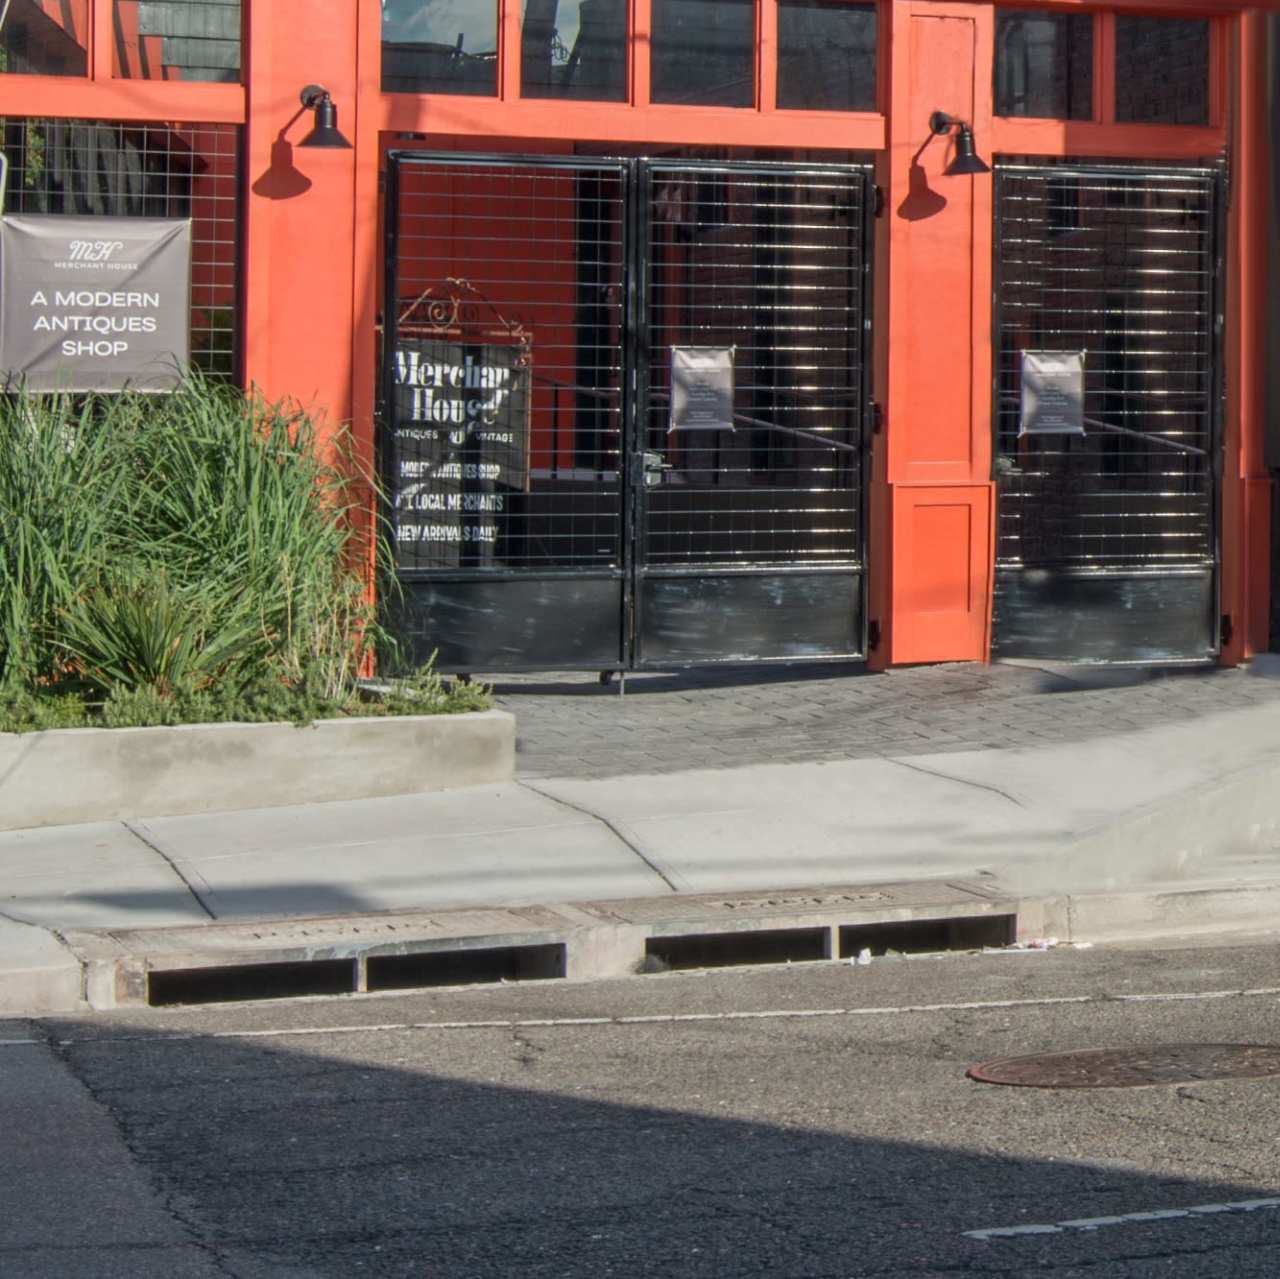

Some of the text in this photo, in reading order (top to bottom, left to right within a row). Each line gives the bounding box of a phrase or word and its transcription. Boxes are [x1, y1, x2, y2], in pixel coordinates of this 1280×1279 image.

[69, 239, 124, 261] MH
[54, 261, 139, 271] MERCHANT HOUSE
[30, 291, 160, 308] A MODERN
[33, 316, 157, 335] ANTIQUES
[61, 340, 129, 357] SHOP
[394, 351, 518, 390] Merchan
[415, 493, 446, 511] LOCAL
